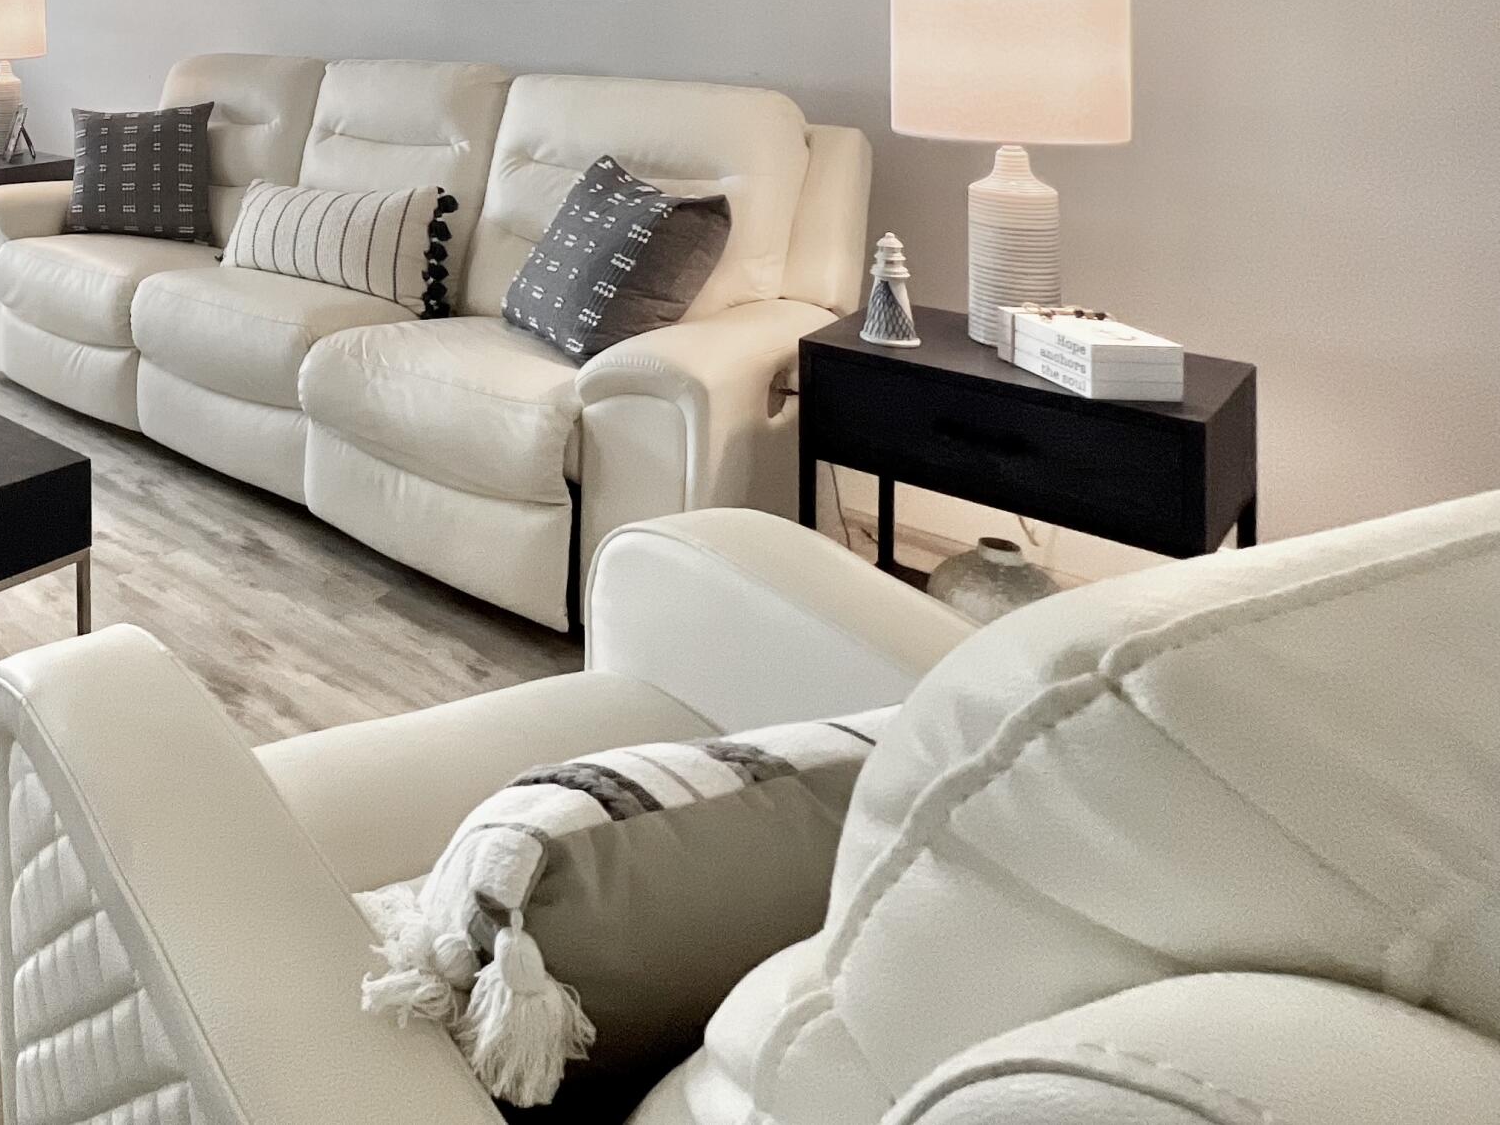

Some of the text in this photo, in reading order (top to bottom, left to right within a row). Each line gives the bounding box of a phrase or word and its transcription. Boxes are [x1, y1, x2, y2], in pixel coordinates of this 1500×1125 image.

[1057, 333, 1086, 355] Hope
[1040, 348, 1086, 374] anchors
[1041, 362, 1086, 392] the soul
